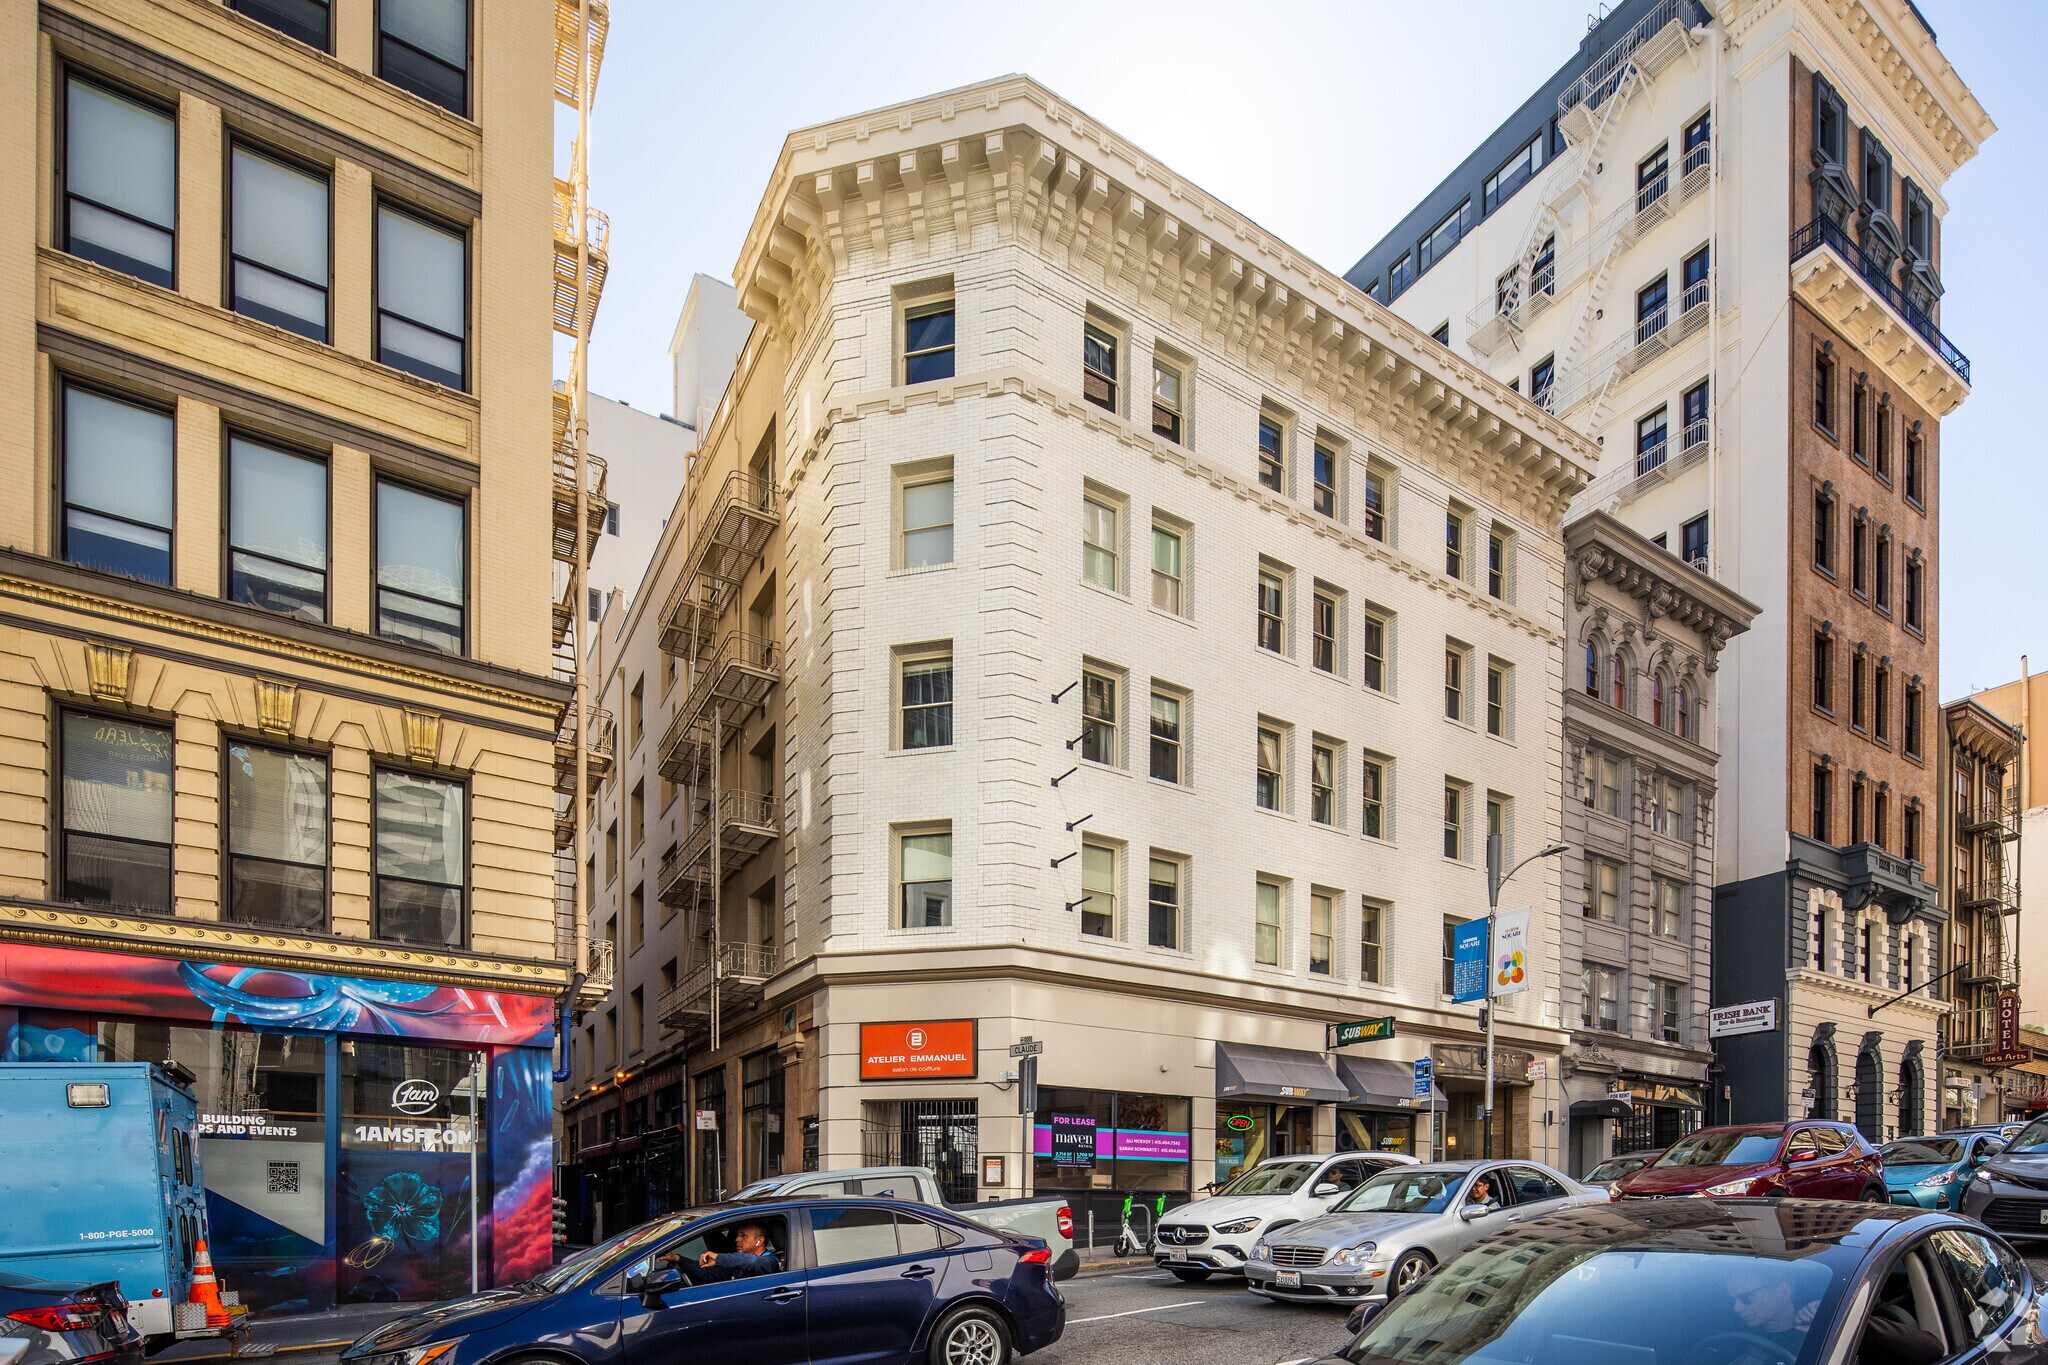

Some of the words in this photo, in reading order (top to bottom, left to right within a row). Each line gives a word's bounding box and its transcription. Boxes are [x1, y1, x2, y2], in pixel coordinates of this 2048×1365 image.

[1501, 930, 1522, 940] SQUARE
[1458, 940, 1481, 949] SQUARE
[1713, 1009, 1741, 1021] IRISH
[1742, 1005, 1771, 1017] BANK
[2001, 998, 2013, 1050] HOTEL
[1341, 1022, 1384, 1040] SUBWAY
[1014, 1044, 1037, 1054] CLAUDE
[867, 1055, 906, 1064] ATELIER
[910, 1053, 967, 1062] EMMANUEL
[1494, 1052, 1516, 1068] 425
[1279, 1086, 1310, 1097] SUBWAY
[202, 1114, 266, 1125] BUILDING
[1053, 1116, 1070, 1125] FOR
[1071, 1117, 1096, 1126] LEASE
[1230, 1118, 1251, 1129] OPEN
[216, 1124, 247, 1134] AND
[249, 1126, 298, 1136] EVENTS
[1055, 1133, 1093, 1144] maven
[1380, 1137, 1405, 1146] SUBWAY
[79, 1228, 154, 1240] 1-800-PGE-5000
